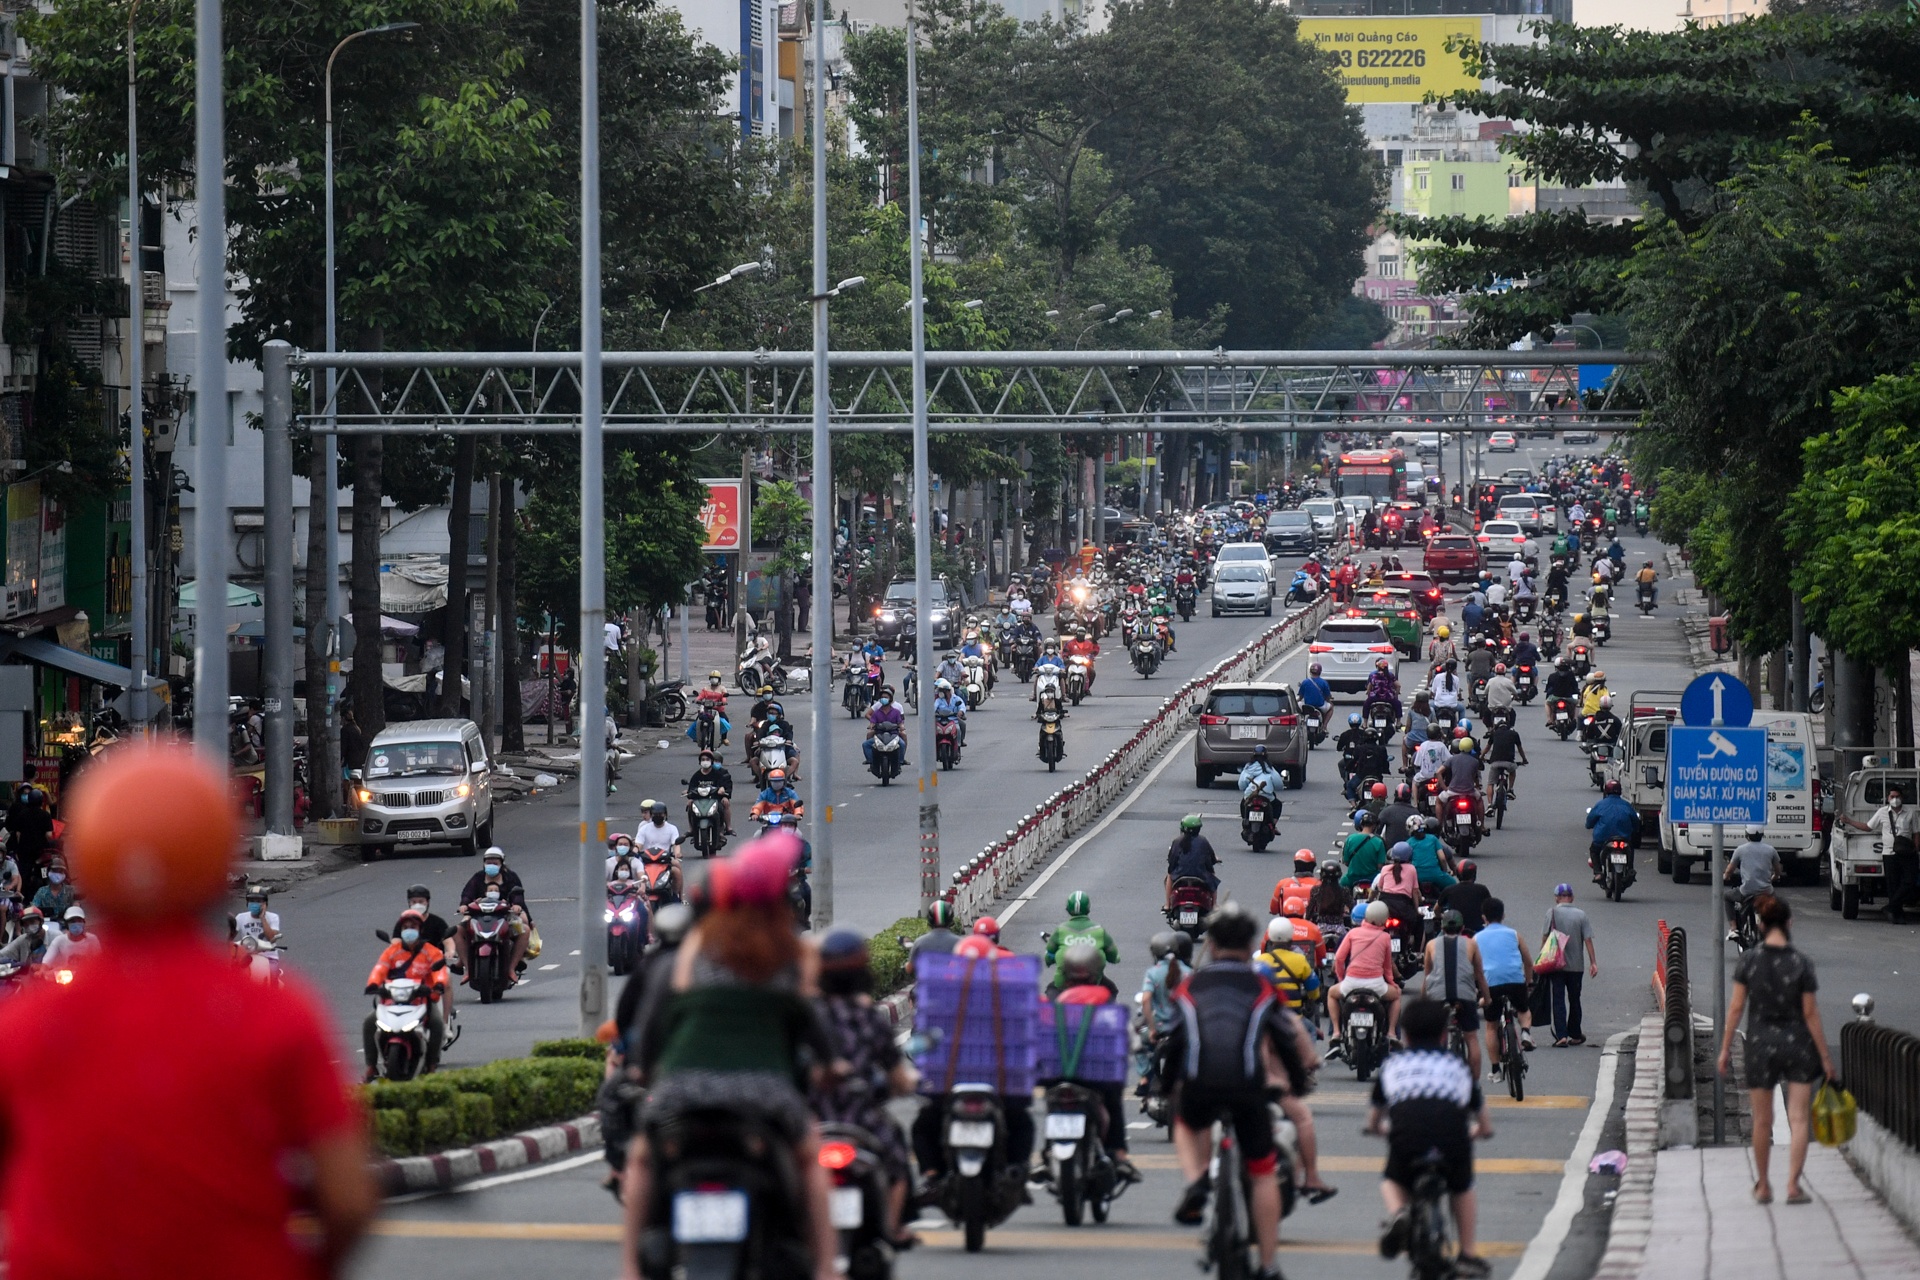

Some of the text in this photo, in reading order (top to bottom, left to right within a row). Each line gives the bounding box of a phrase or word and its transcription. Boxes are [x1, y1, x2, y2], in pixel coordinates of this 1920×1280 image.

[1314, 31, 1418, 44] Xin Mời Quảng Cáo
[1357, 49, 1426, 68] 622226
[1678, 762, 1758, 782] TUYẾN ĐƯỜNG CÓ
[1674, 783, 1697, 800] GIÁM
[1722, 782, 1735, 800] XỬ
[1737, 786, 1762, 804] PHẠT
[1684, 801, 1751, 820] BẰNG CAMERA
[1064, 935, 1096, 947] Grab
